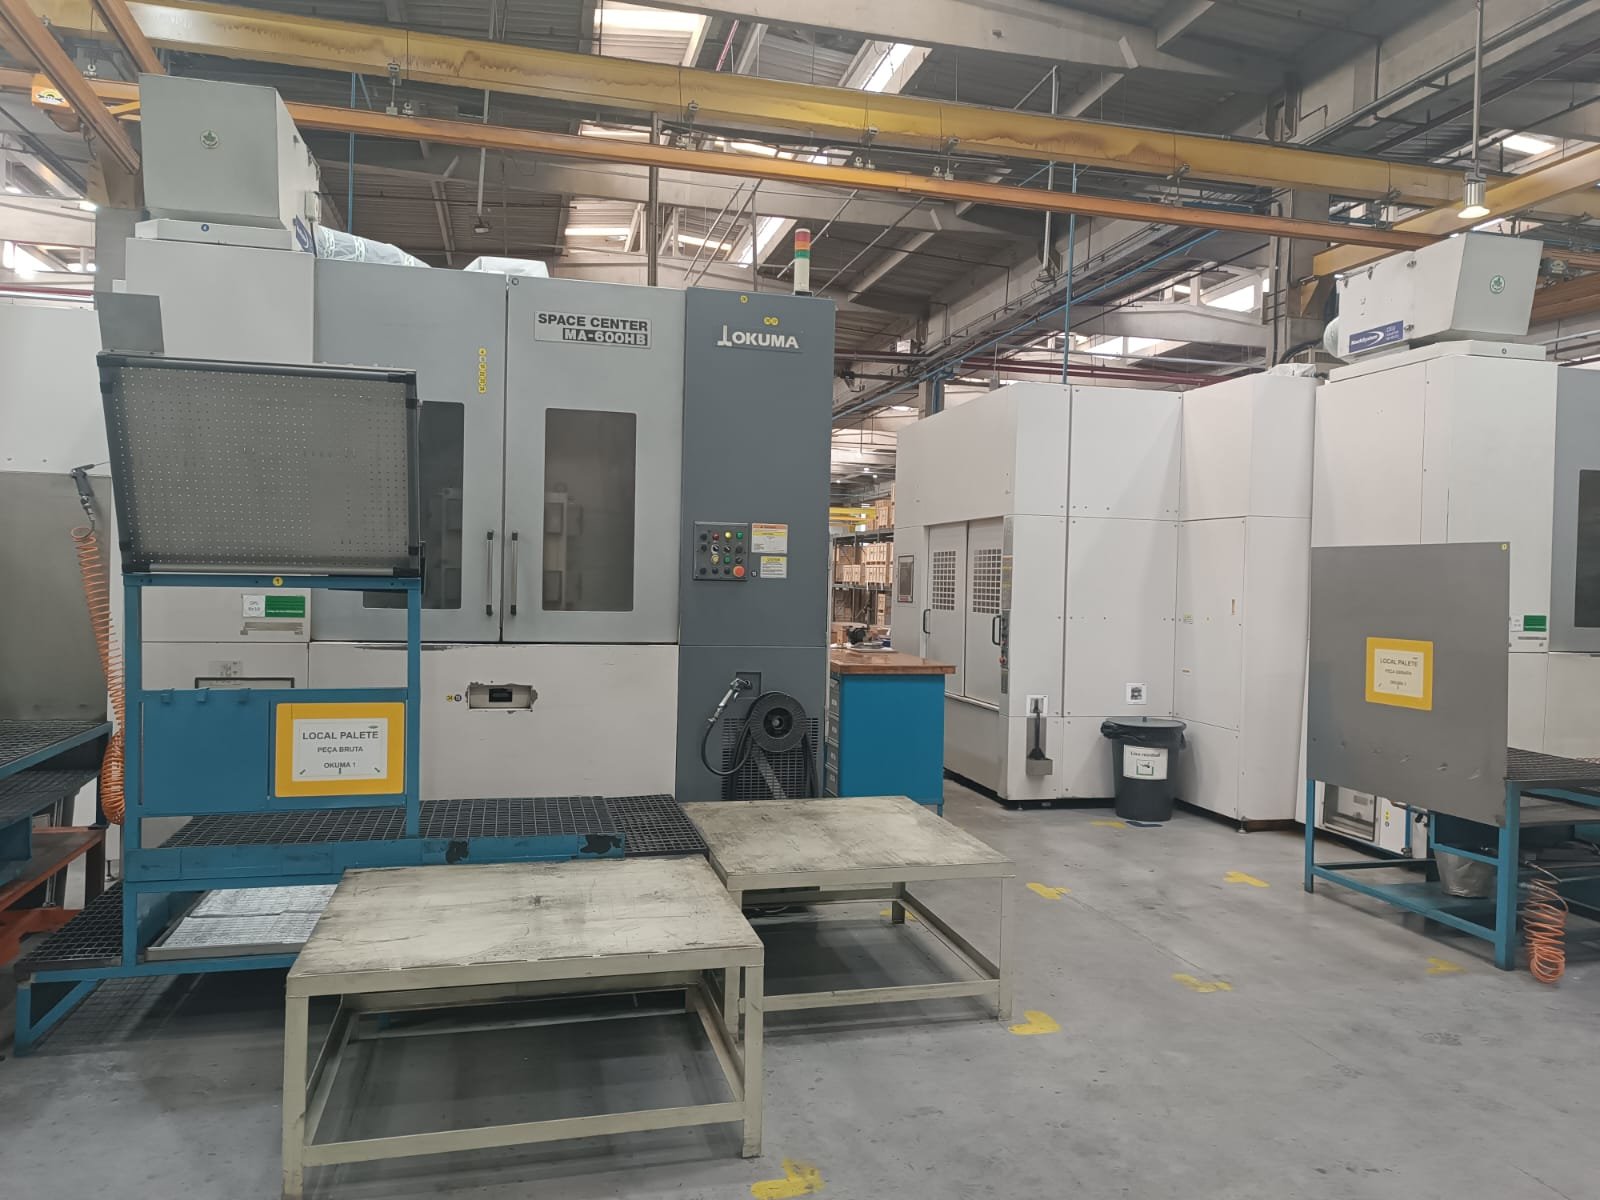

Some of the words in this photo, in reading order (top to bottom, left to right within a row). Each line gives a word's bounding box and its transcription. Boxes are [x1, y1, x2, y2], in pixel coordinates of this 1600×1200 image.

[537, 313, 586, 327] SPACE
[590, 317, 648, 332] CENTER
[563, 327, 648, 347] MA-600HB
[302, 731, 337, 740] LOCAL
[339, 730, 379, 740] PALETE
[317, 746, 337, 754] PEÇA
[338, 745, 364, 753] BRUTA
[323, 761, 352, 769] OKUMA
